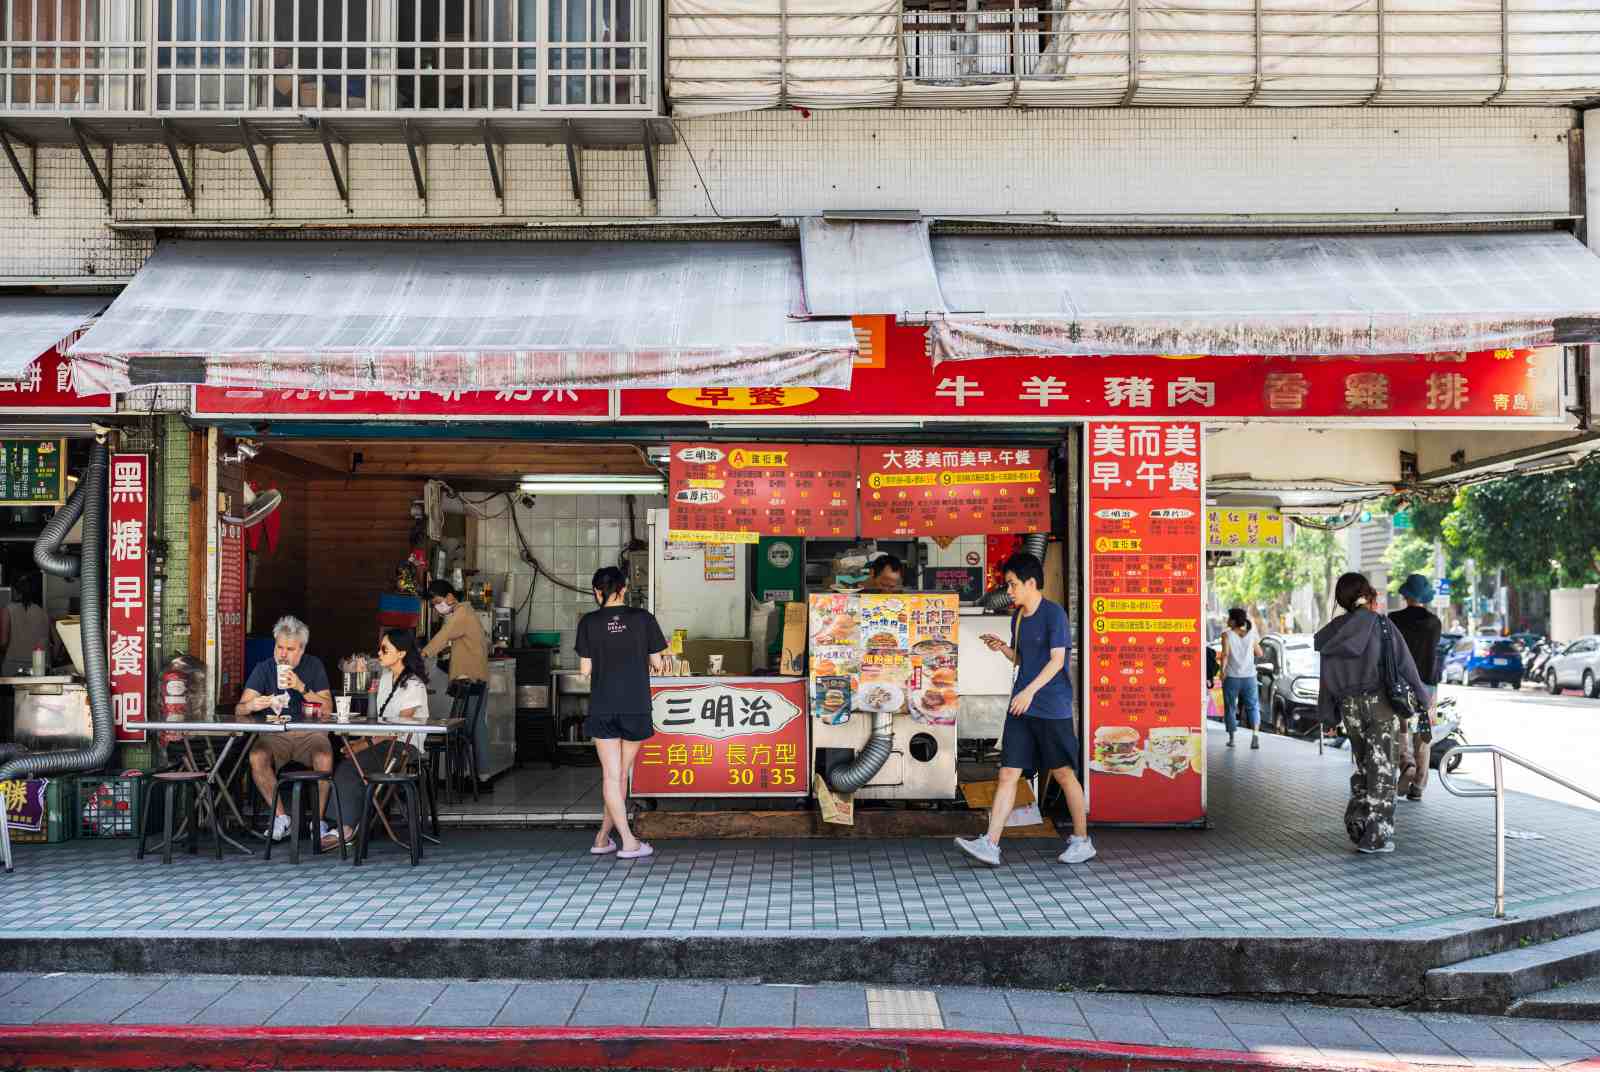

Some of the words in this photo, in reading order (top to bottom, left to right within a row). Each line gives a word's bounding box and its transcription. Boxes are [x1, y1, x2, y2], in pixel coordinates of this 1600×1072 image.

[1093, 425, 1197, 457] 美而美
[684, 451, 718, 461] 三明治
[733, 452, 744, 463] A
[873, 478, 881, 489] 8
[943, 474, 951, 485] 9
[112, 462, 143, 733] 黑糖早餐吧
[1097, 600, 1105, 613] 8
[1097, 619, 1105, 632] 9
[662, 694, 773, 728] 三明治
[641, 743, 713, 765] 三角型
[726, 743, 797, 766] 長方型
[668, 769, 695, 785] 20
[728, 769, 754, 785] 30
[770, 768, 796, 785] 35
